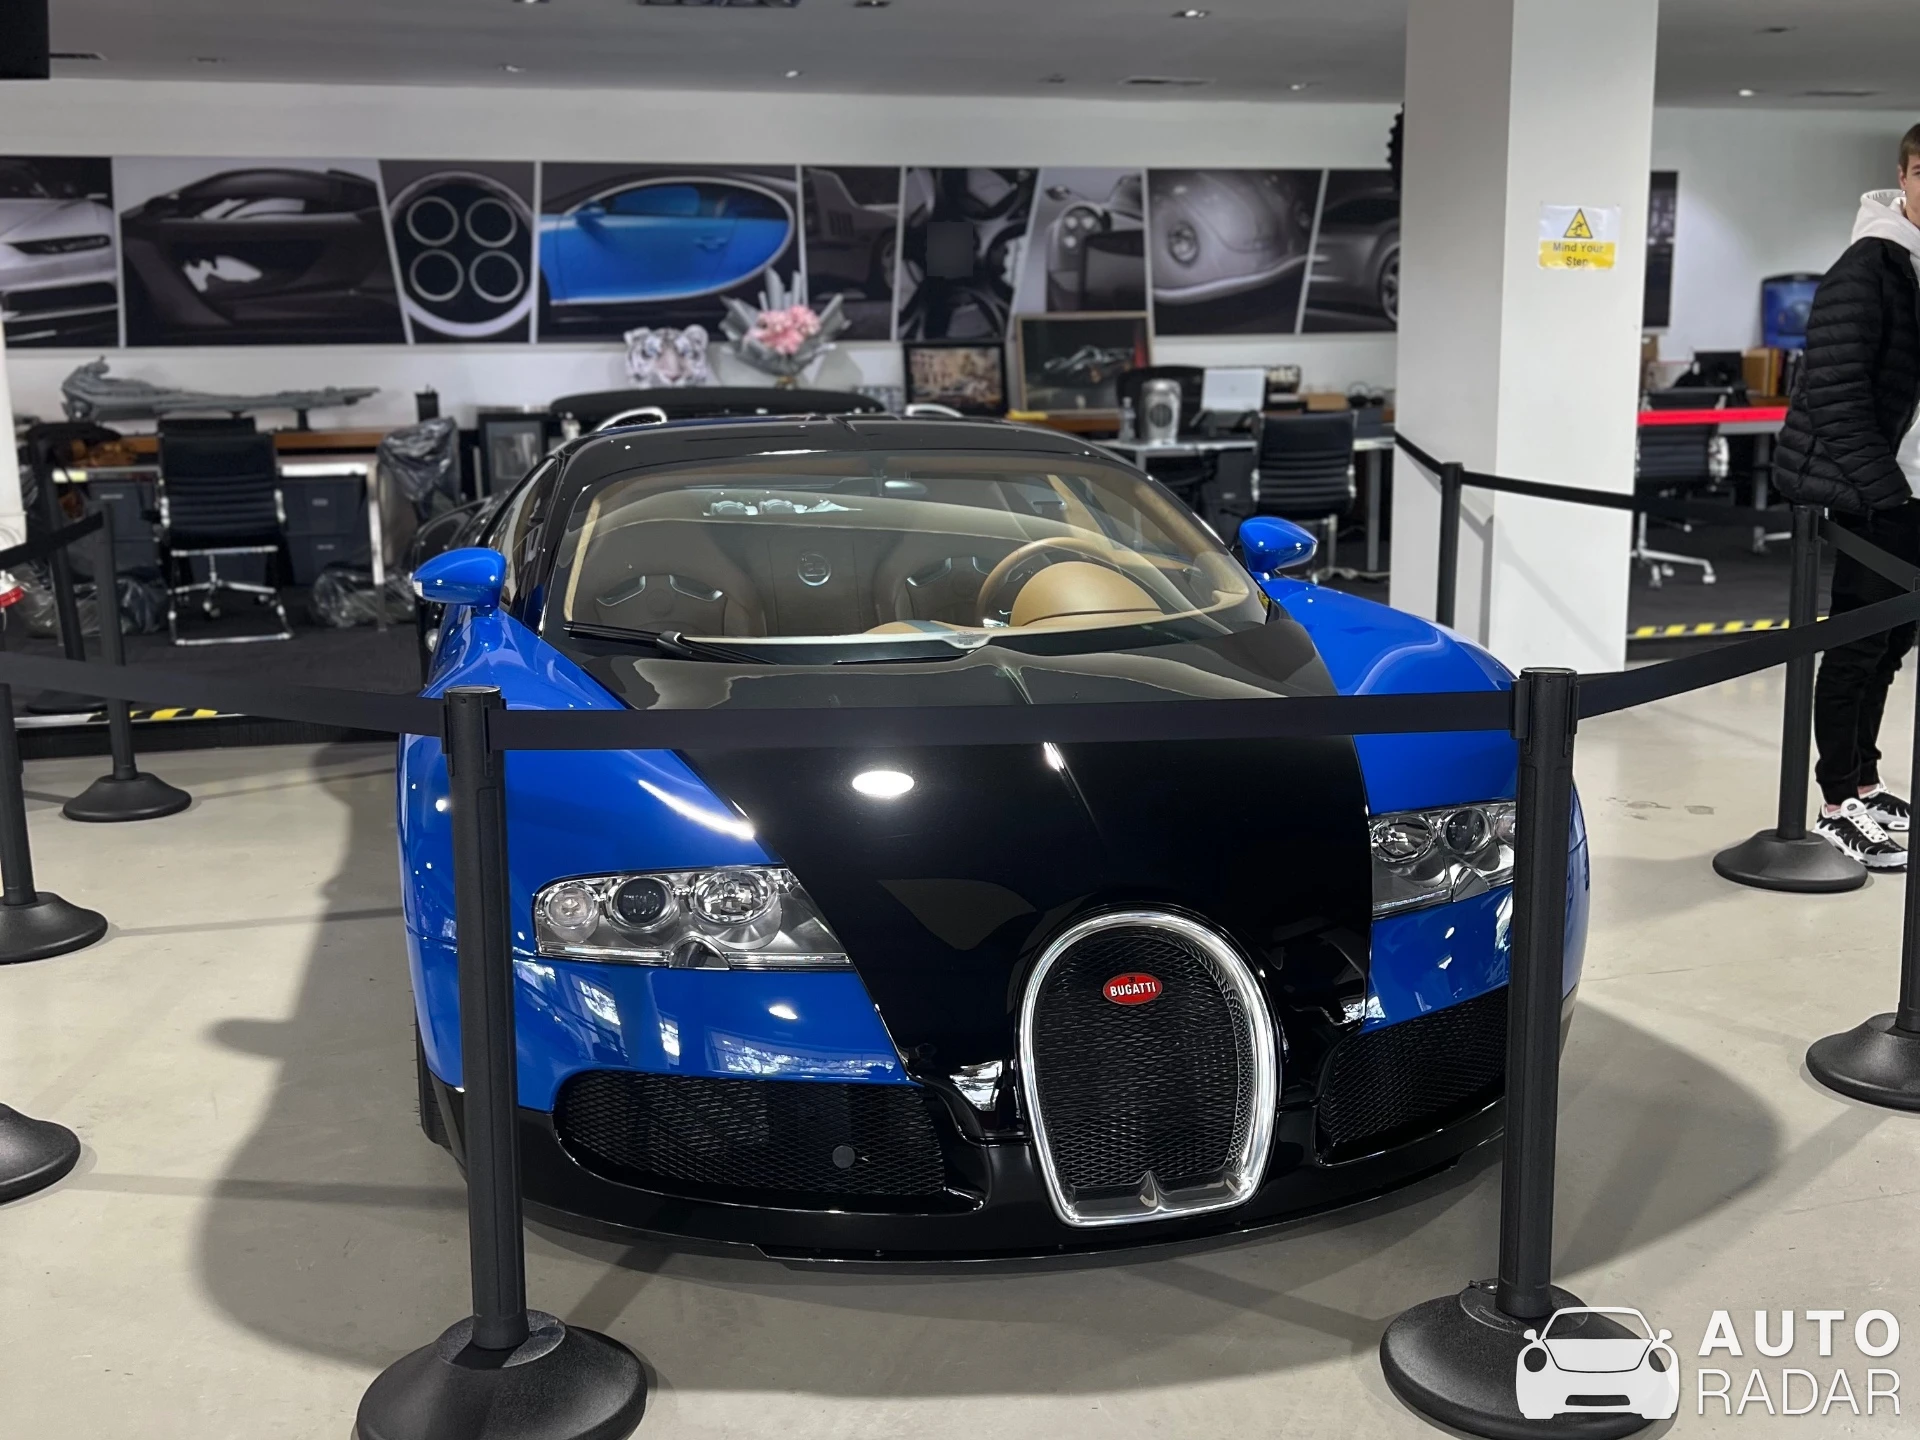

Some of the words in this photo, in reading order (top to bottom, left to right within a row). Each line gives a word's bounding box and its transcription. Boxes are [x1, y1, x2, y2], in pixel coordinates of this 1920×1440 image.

[1553, 242, 1577, 252] Mind
[1580, 243, 1604, 253] Your
[1109, 982, 1156, 997] BUGATTI
